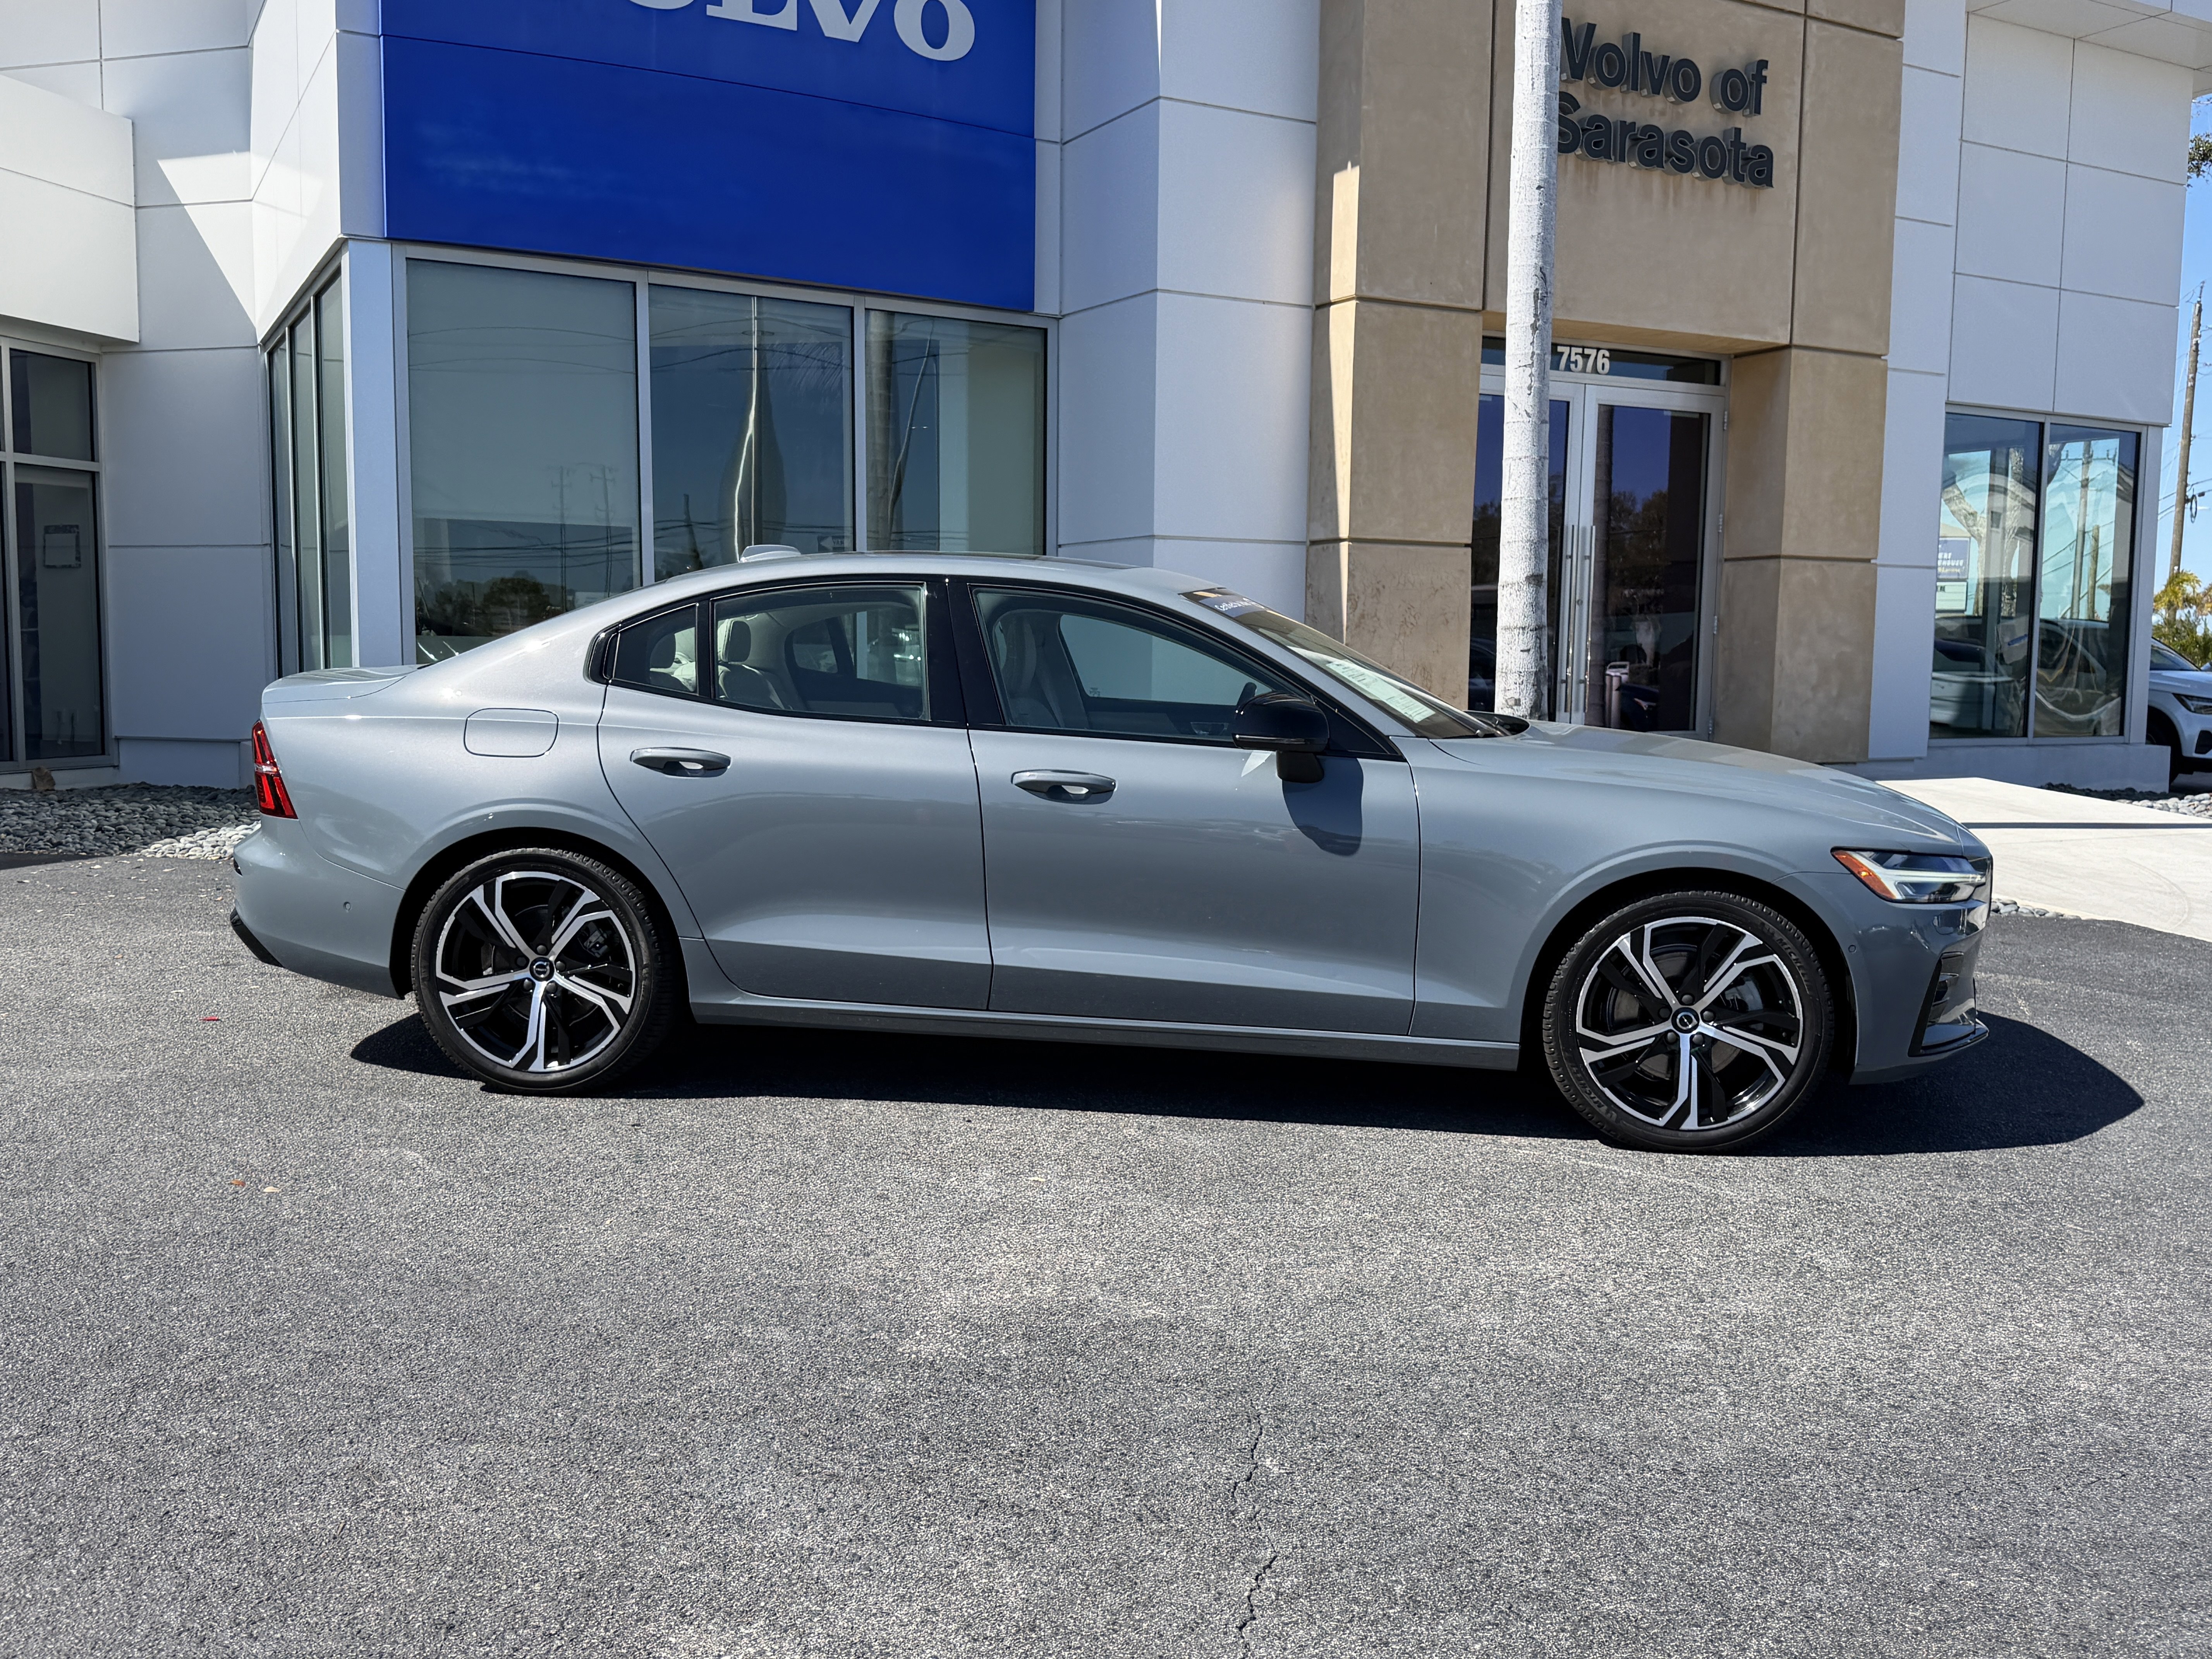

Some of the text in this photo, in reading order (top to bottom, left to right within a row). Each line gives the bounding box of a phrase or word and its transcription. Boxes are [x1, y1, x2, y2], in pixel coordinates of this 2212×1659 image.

[629, 0, 975, 61] LVO
[1561, 17, 1769, 116] Volvo of
[1558, 91, 1774, 188] Sarasota
[1557, 346, 1610, 374] 7576
